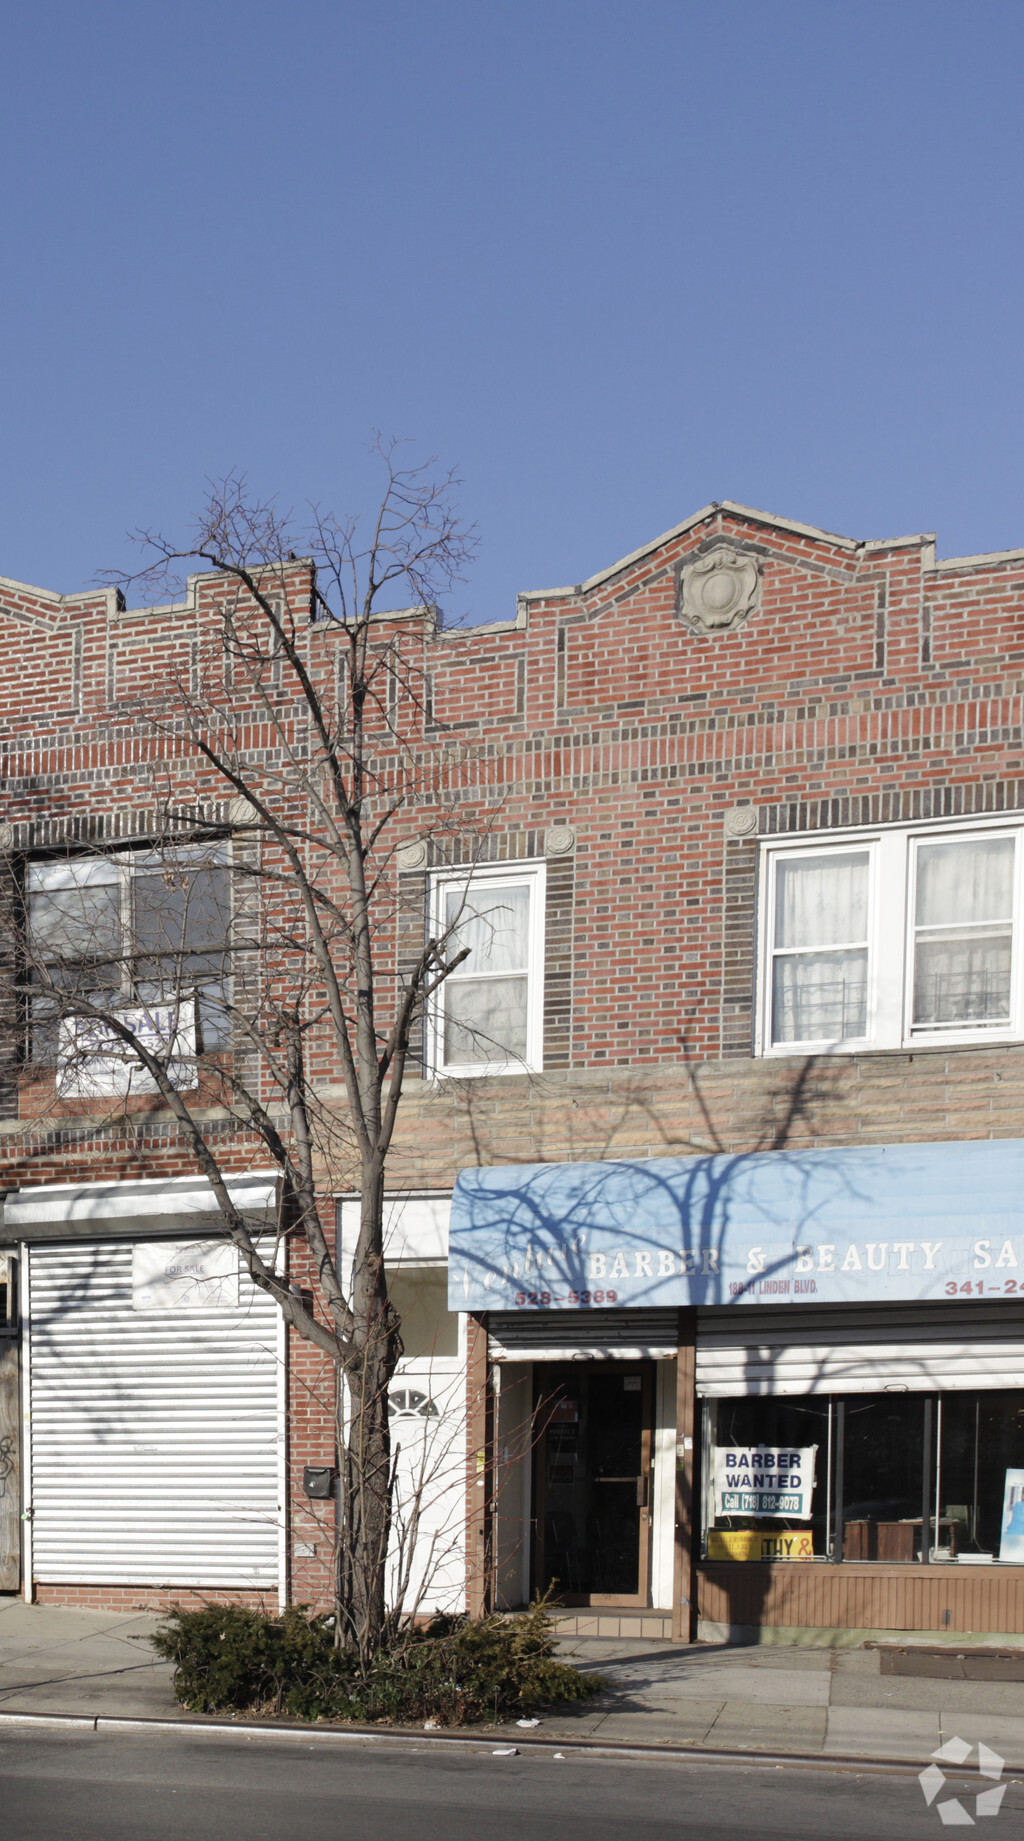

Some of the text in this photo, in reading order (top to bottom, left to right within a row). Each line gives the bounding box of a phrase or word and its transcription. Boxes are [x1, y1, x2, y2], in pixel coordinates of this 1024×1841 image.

[588, 1248, 720, 1279] BARBER
[746, 1247, 767, 1274] &
[794, 1241, 944, 1273] BEAUTY
[973, 1239, 1024, 1269] SA
[165, 1264, 205, 1274] FOR SALE
[759, 1280, 790, 1294] LINDEN
[794, 1279, 818, 1294] BLVD.
[515, 1289, 618, 1306] 528-5389
[726, 1453, 802, 1468] BARBER
[726, 1474, 802, 1488] WANTED
[724, 1493, 740, 1509] Call
[741, 1493, 760, 1511] (718)
